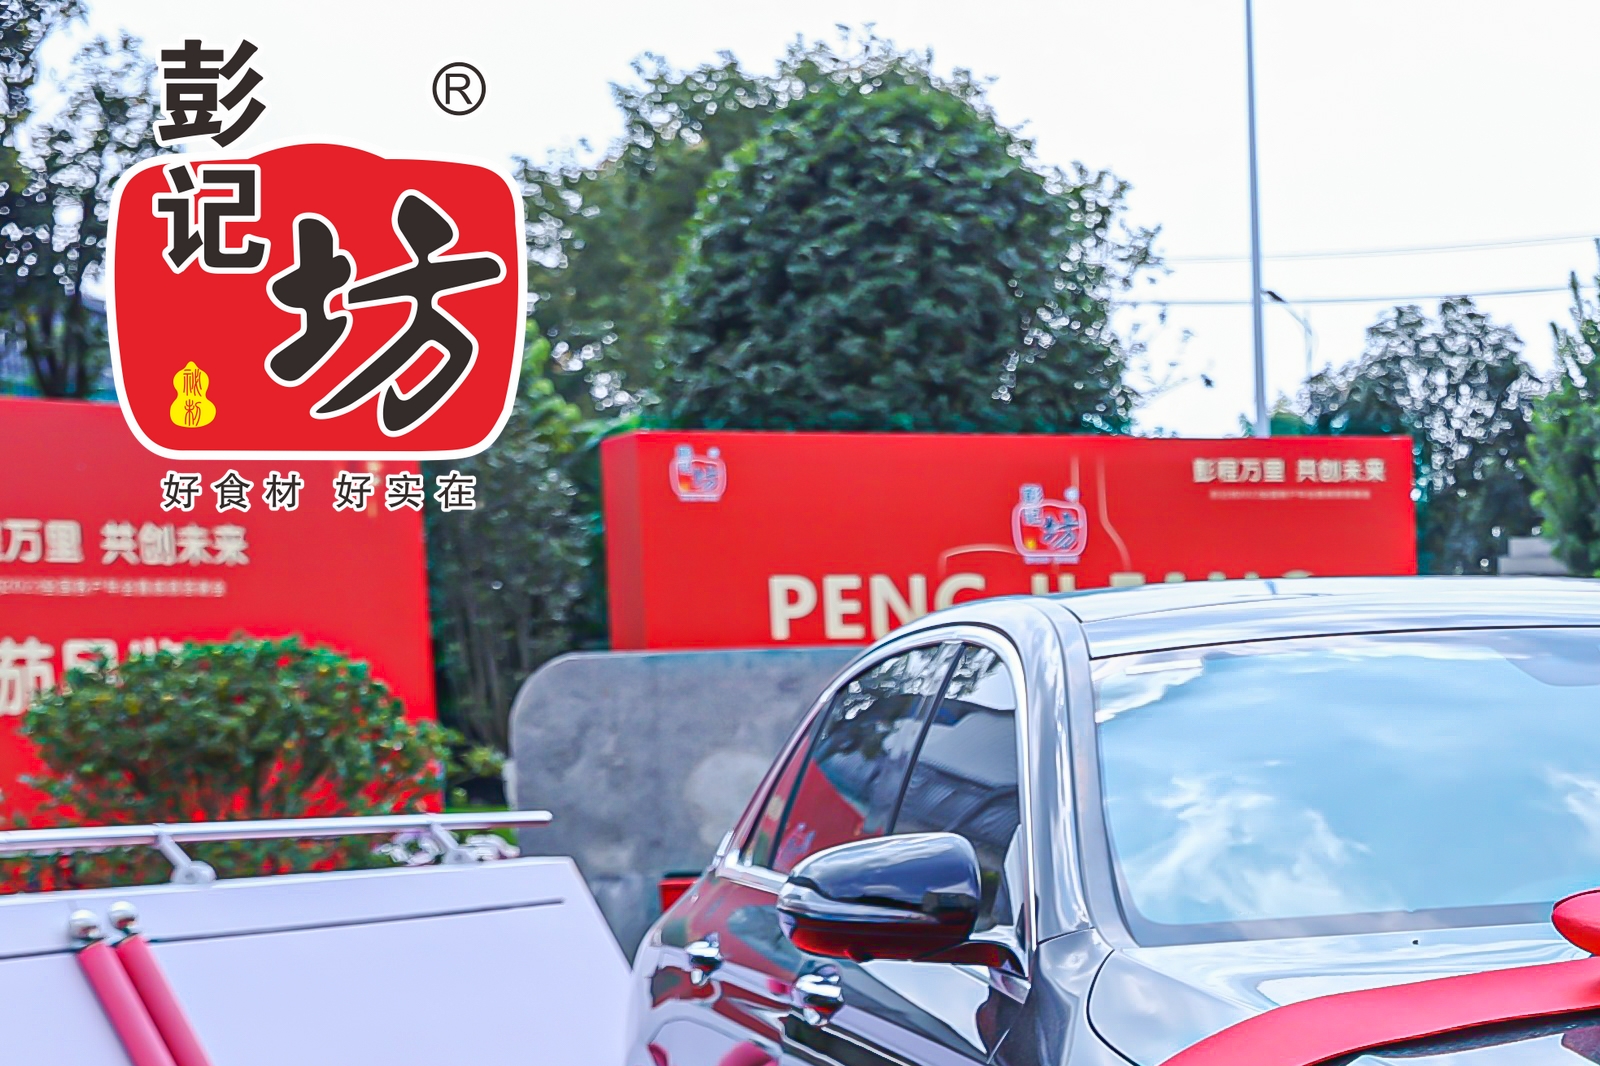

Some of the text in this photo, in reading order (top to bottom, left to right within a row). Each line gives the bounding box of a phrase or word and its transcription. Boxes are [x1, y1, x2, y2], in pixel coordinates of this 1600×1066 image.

[0, 518, 249, 566] 万里 共创未来
